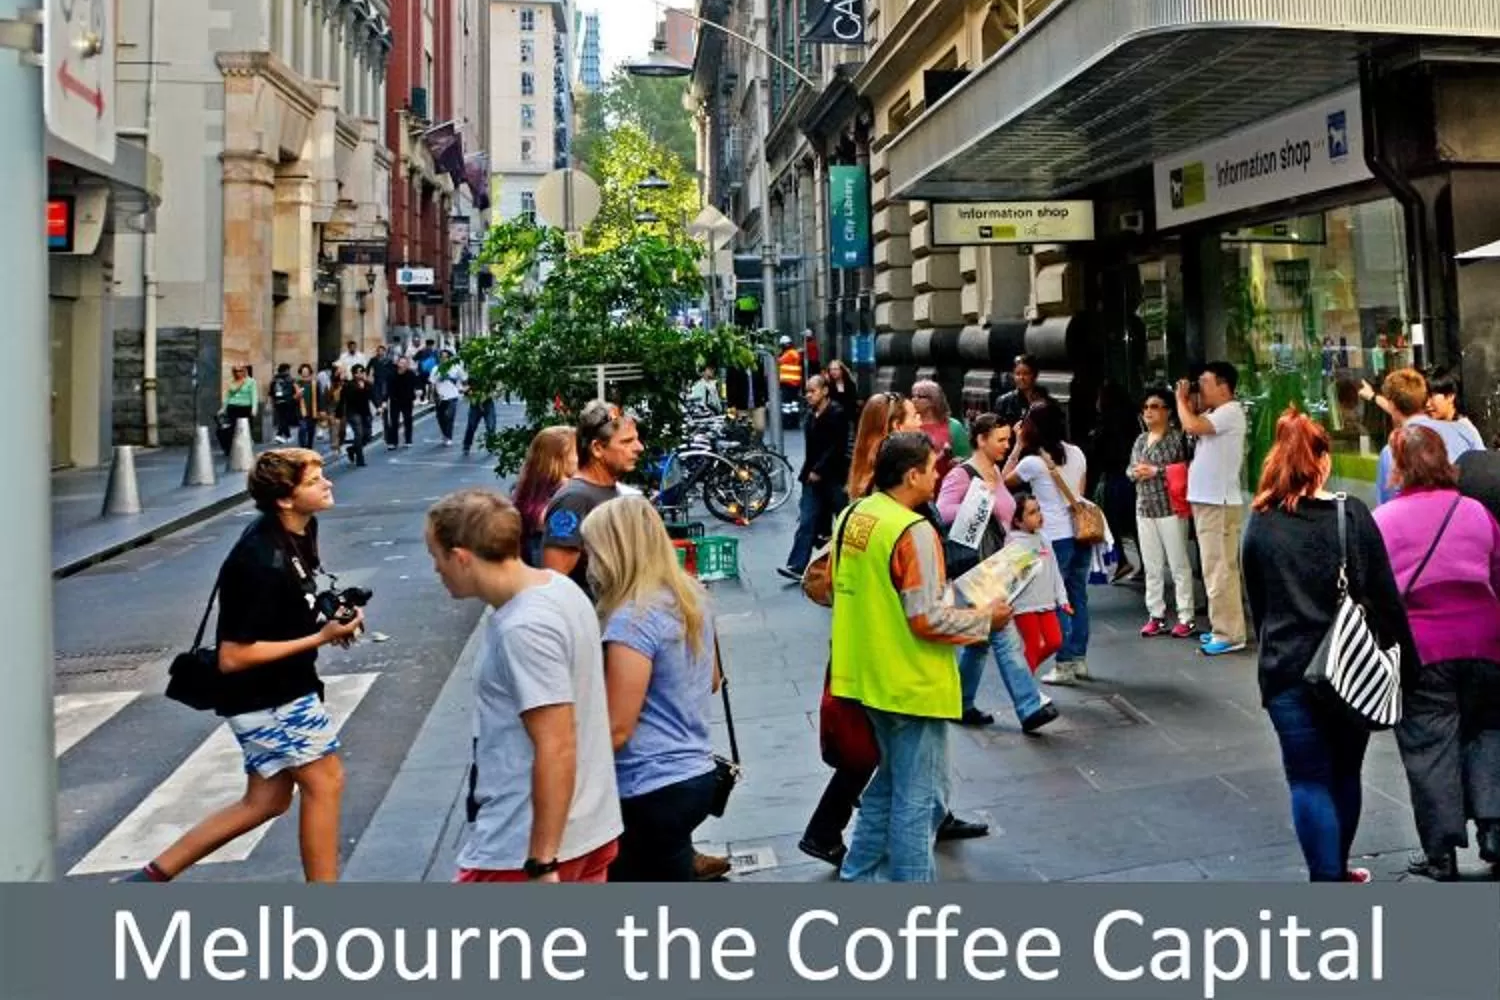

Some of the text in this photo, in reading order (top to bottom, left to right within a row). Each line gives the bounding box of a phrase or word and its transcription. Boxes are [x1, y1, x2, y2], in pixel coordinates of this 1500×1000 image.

[1279, 136, 1311, 174] shop
[843, 177, 857, 242] City Library
[1037, 206, 1069, 220] shop
